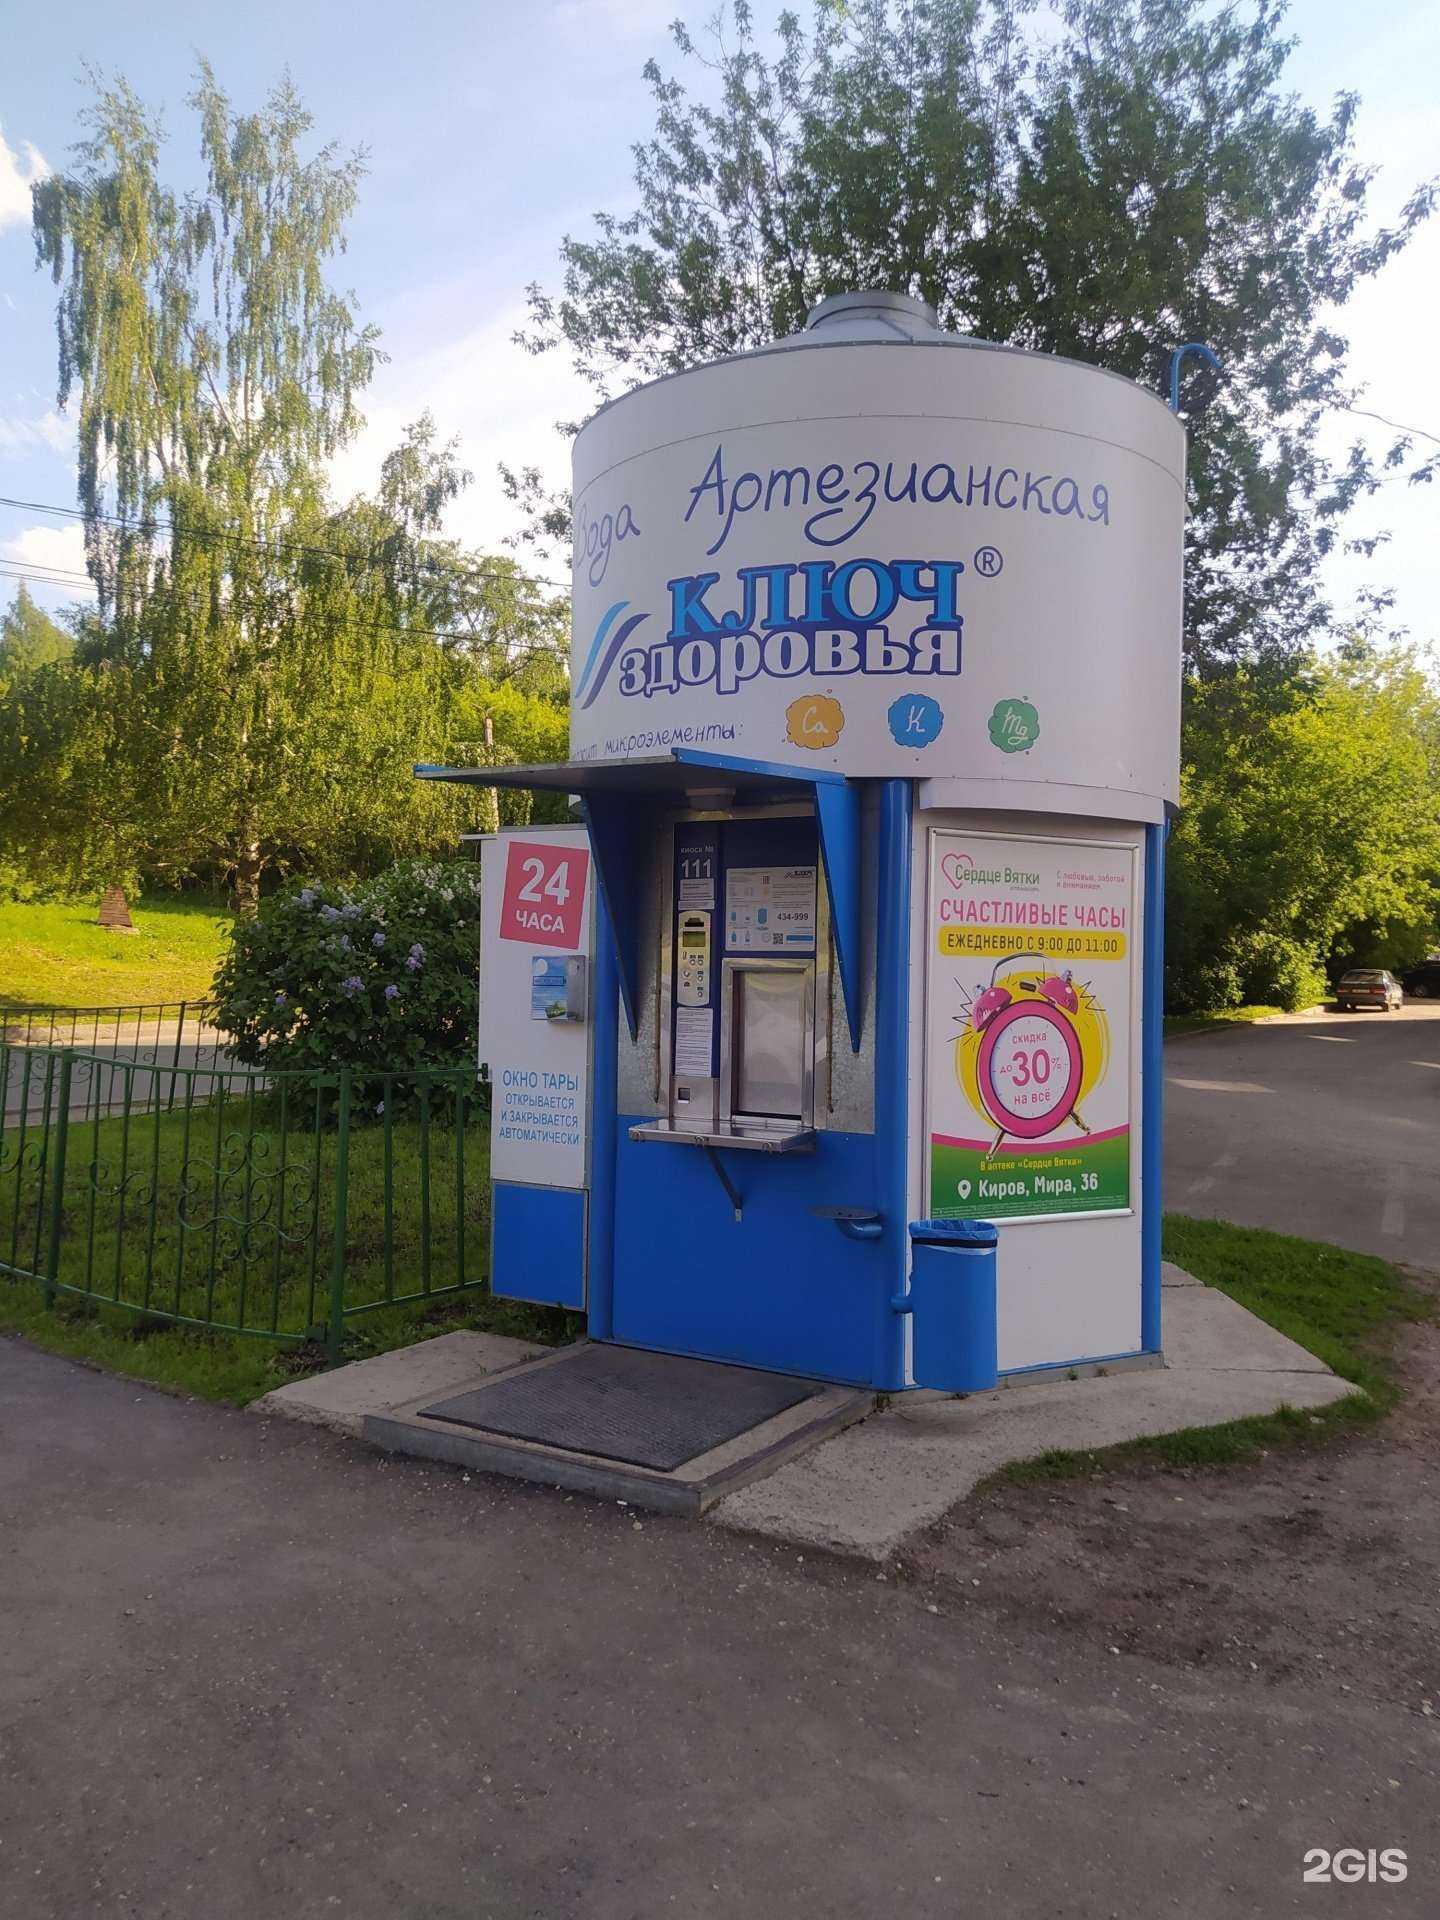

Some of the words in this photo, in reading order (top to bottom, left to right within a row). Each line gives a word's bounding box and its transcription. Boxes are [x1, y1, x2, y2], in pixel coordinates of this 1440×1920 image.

[684, 444, 1111, 556] Артезианская
[667, 557, 965, 640] КЛЮЧ
[604, 722, 744, 759] микроэлементы:
[681, 858, 711, 878] 111
[955, 864, 1001, 884] Сердце
[1004, 868, 1040, 884] Вятки
[518, 857, 570, 906] 24
[515, 909, 565, 934] ЧАСА
[776, 912, 809, 921] 434-999
[940, 899, 1068, 926] СЧАСТЛИВЫЕ
[1074, 906, 1126, 929] ЧАСЫ
[947, 933, 1023, 950] ЕЖЕДНЕВНО
[1027, 936, 1034, 949] С
[1039, 936, 1063, 950] 9:00
[1066, 938, 1082, 953] ДО
[1085, 939, 1118, 953] 11:00
[1012, 1032, 1047, 1045] скидка
[502, 1070, 538, 1088] ОКНО
[542, 1072, 579, 1091] ТАРЫ
[505, 1092, 575, 1111] ОТКРЫВАЕТСЯ
[1014, 1092, 1028, 1102] на
[501, 1110, 508, 1121] И
[510, 1110, 578, 1128] ЗАКРЫВАЕТСЯ
[499, 1126, 580, 1145] АВТОМАТИЧЕСКИ
[980, 1161, 985, 1171] В
[987, 1161, 1015, 1171] аптеке
[979, 1179, 1030, 1200] Киров,
[1034, 1175, 1077, 1195] Мира,
[1080, 1173, 1099, 1191] 36
